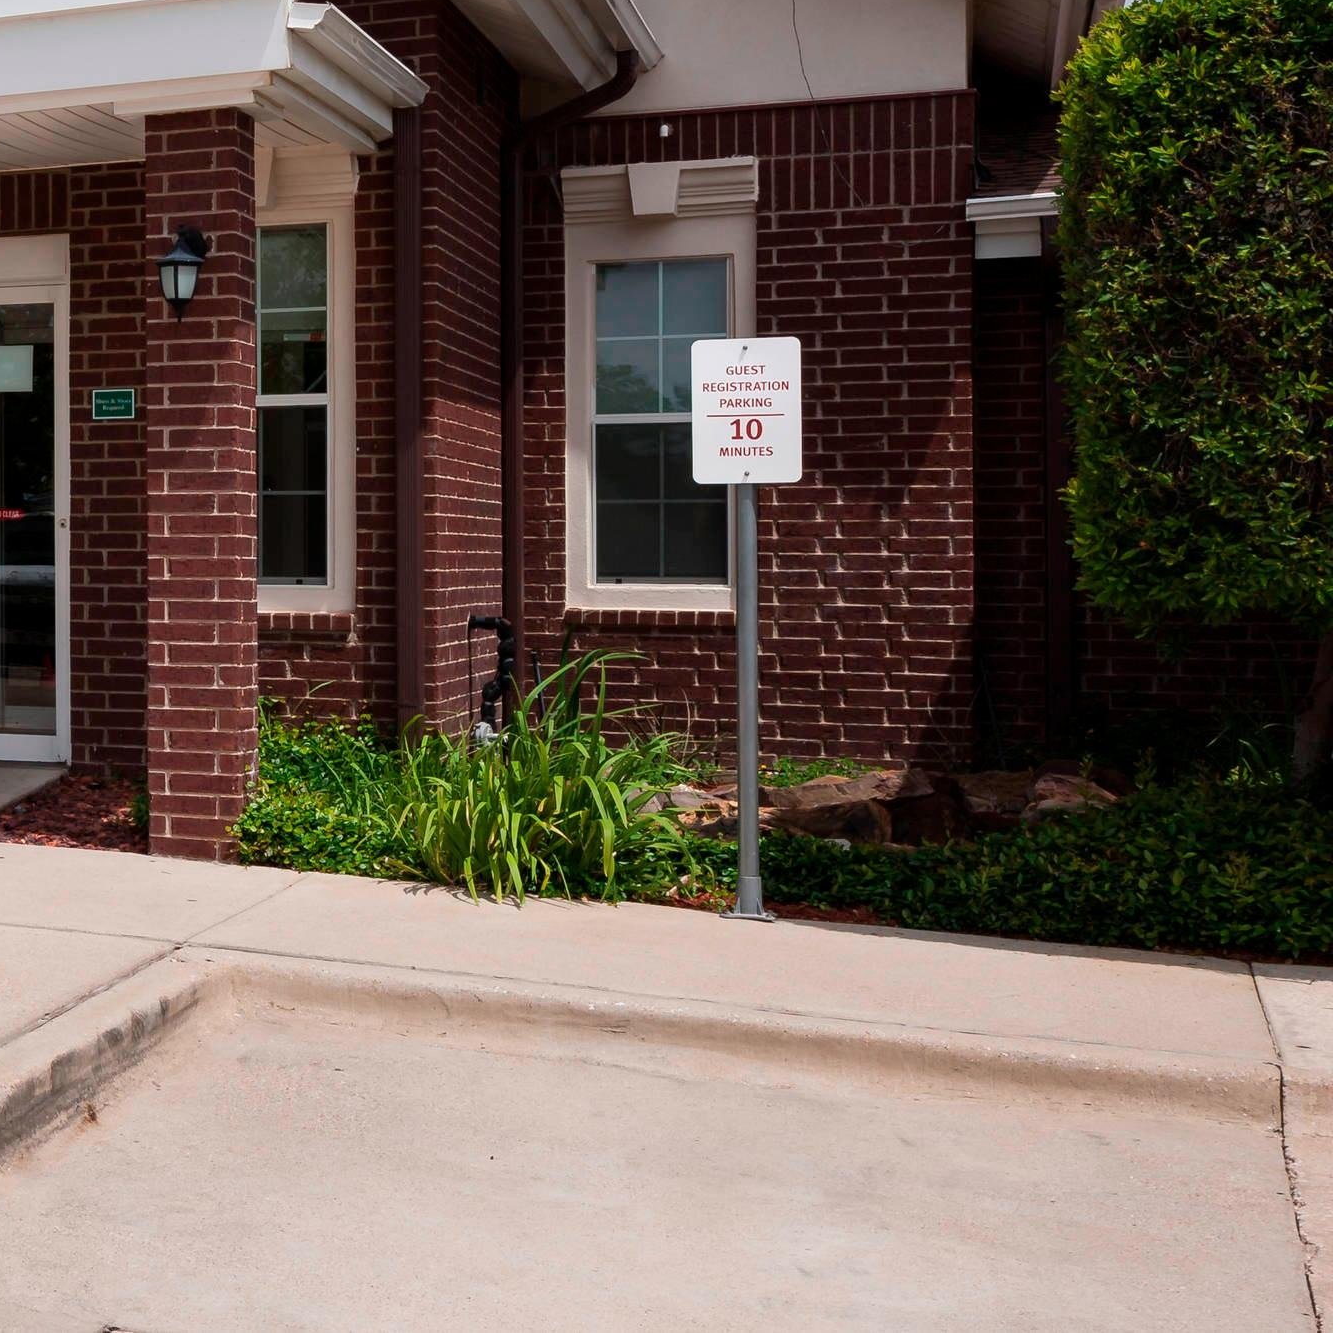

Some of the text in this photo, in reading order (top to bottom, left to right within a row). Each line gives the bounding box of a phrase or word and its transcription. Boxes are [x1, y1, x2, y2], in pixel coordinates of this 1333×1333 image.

[726, 365, 766, 375] GUEST
[702, 381, 790, 392] REGISTRATION
[719, 398, 772, 408] PARKING
[730, 418, 763, 440] 10
[719, 446, 774, 457] MINUTES
